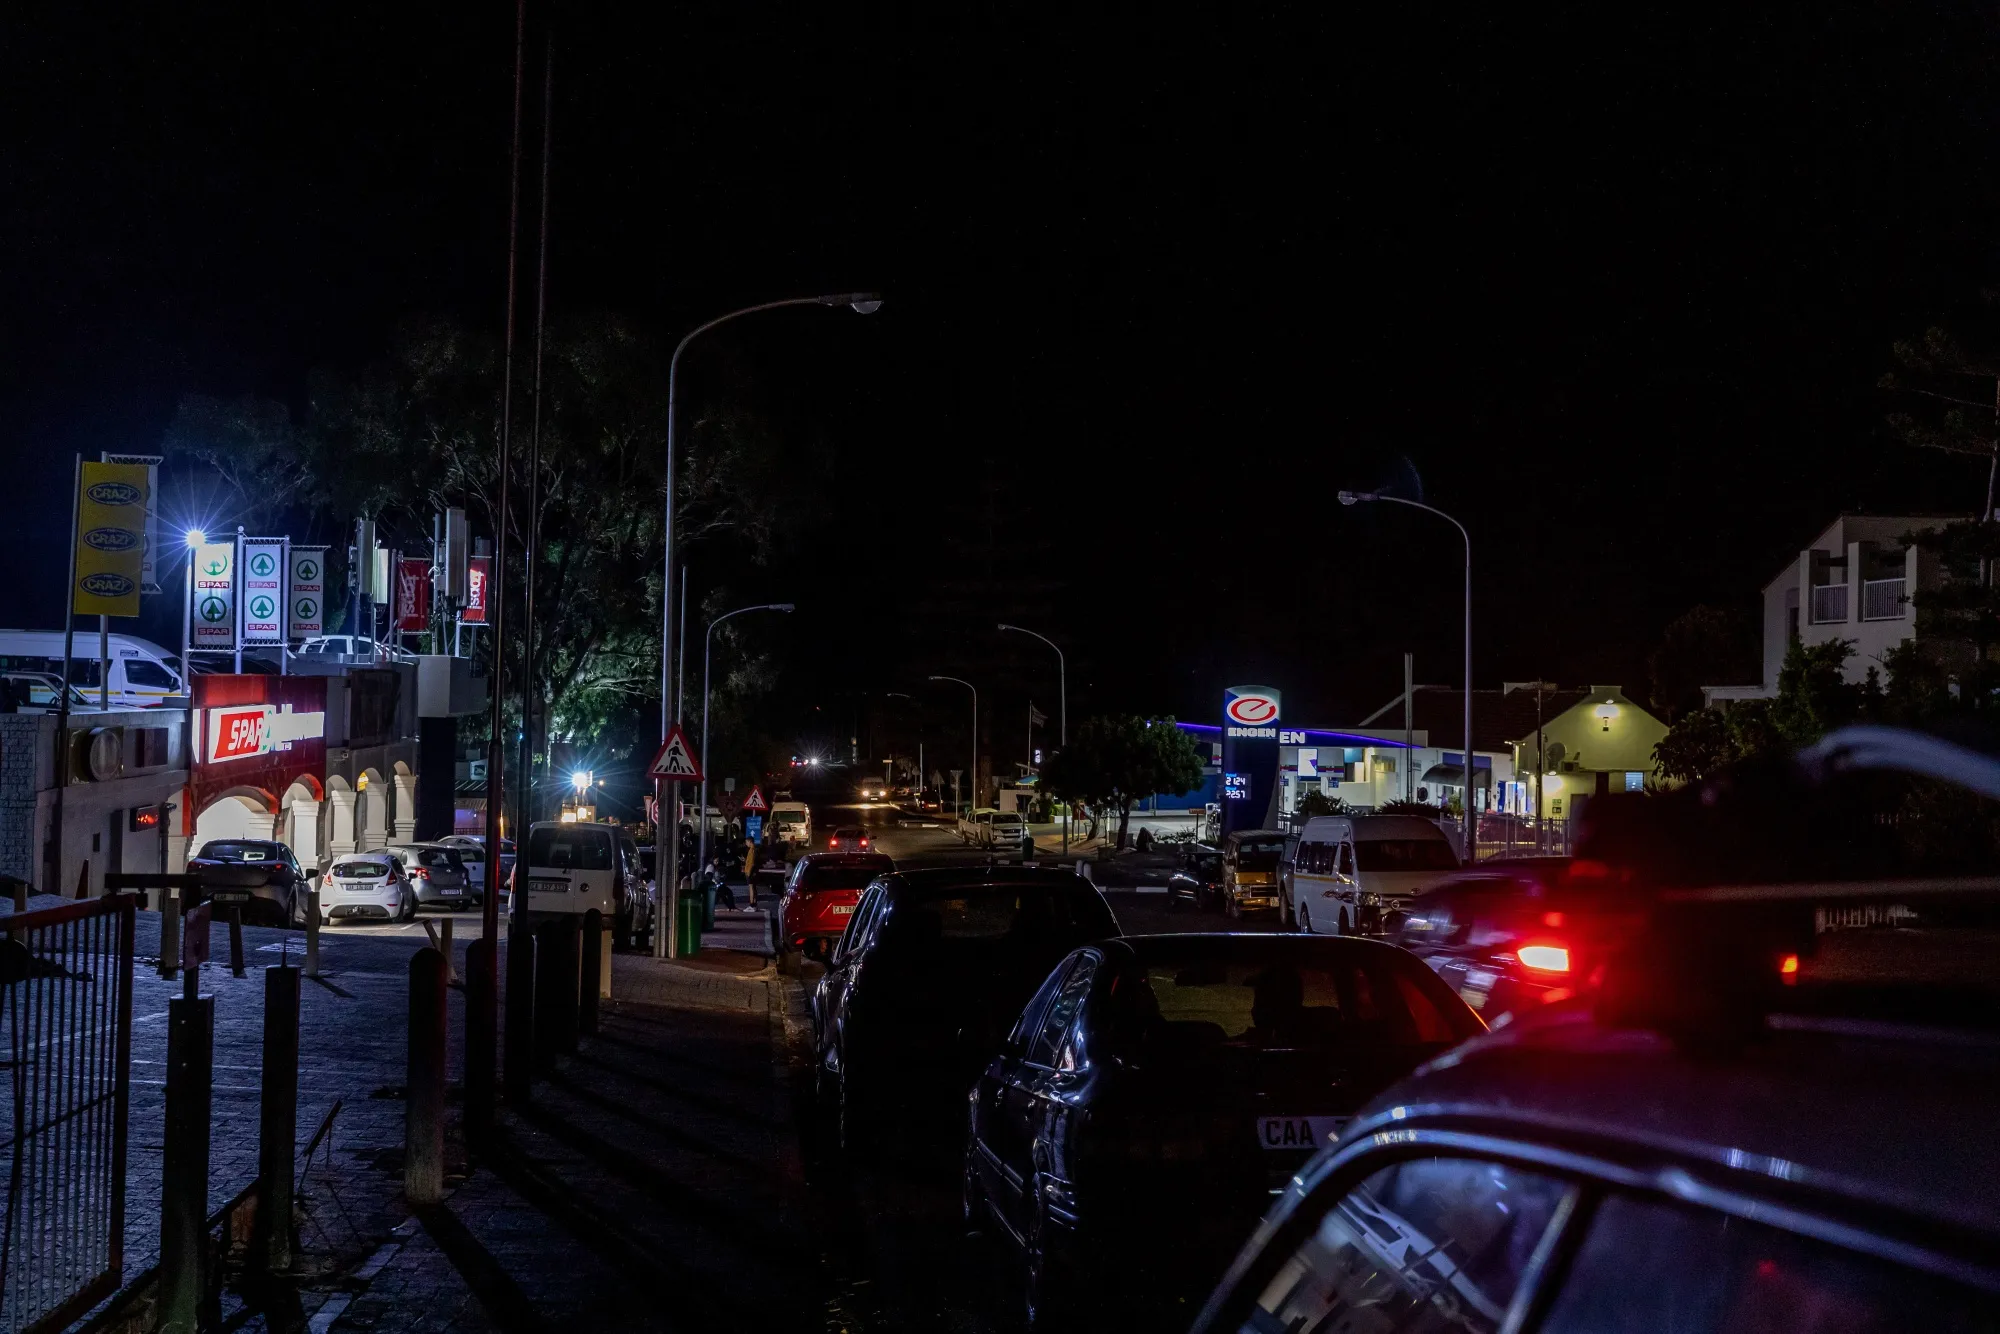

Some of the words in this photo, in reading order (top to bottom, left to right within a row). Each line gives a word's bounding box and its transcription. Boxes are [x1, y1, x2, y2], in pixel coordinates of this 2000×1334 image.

[92, 488, 136, 500] CRAZY
[88, 533, 133, 545] CRAZY
[85, 579, 128, 592] CRAZY
[228, 717, 263, 750] SPAR
[1228, 727, 1276, 737] ENGEN
[1266, 1120, 1314, 1145] CAA
